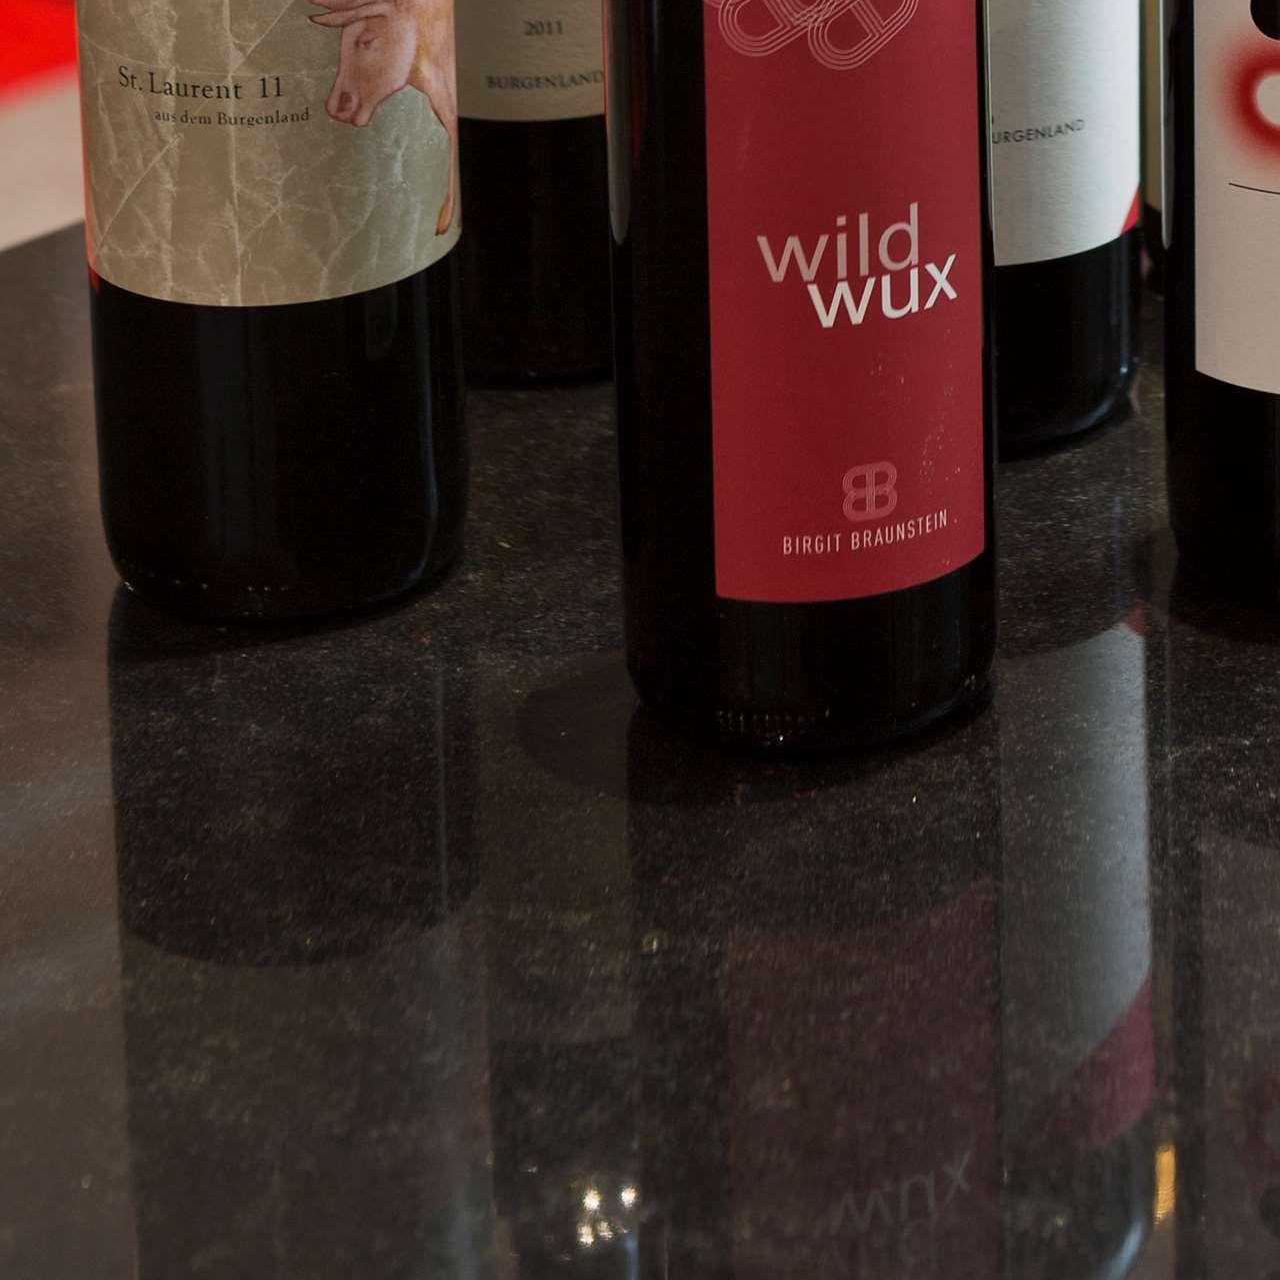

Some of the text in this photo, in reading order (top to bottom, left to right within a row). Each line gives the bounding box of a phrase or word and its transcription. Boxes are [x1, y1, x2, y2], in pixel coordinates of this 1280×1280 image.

[525, 20, 563, 36] 2011
[118, 65, 284, 100] St. Laurent 11
[154, 107, 310, 129] aus dem Burgenland
[756, 201, 919, 283] wild
[807, 253, 958, 329] wux
[782, 508, 948, 556] BIRGIT BRAUNSTEIN
